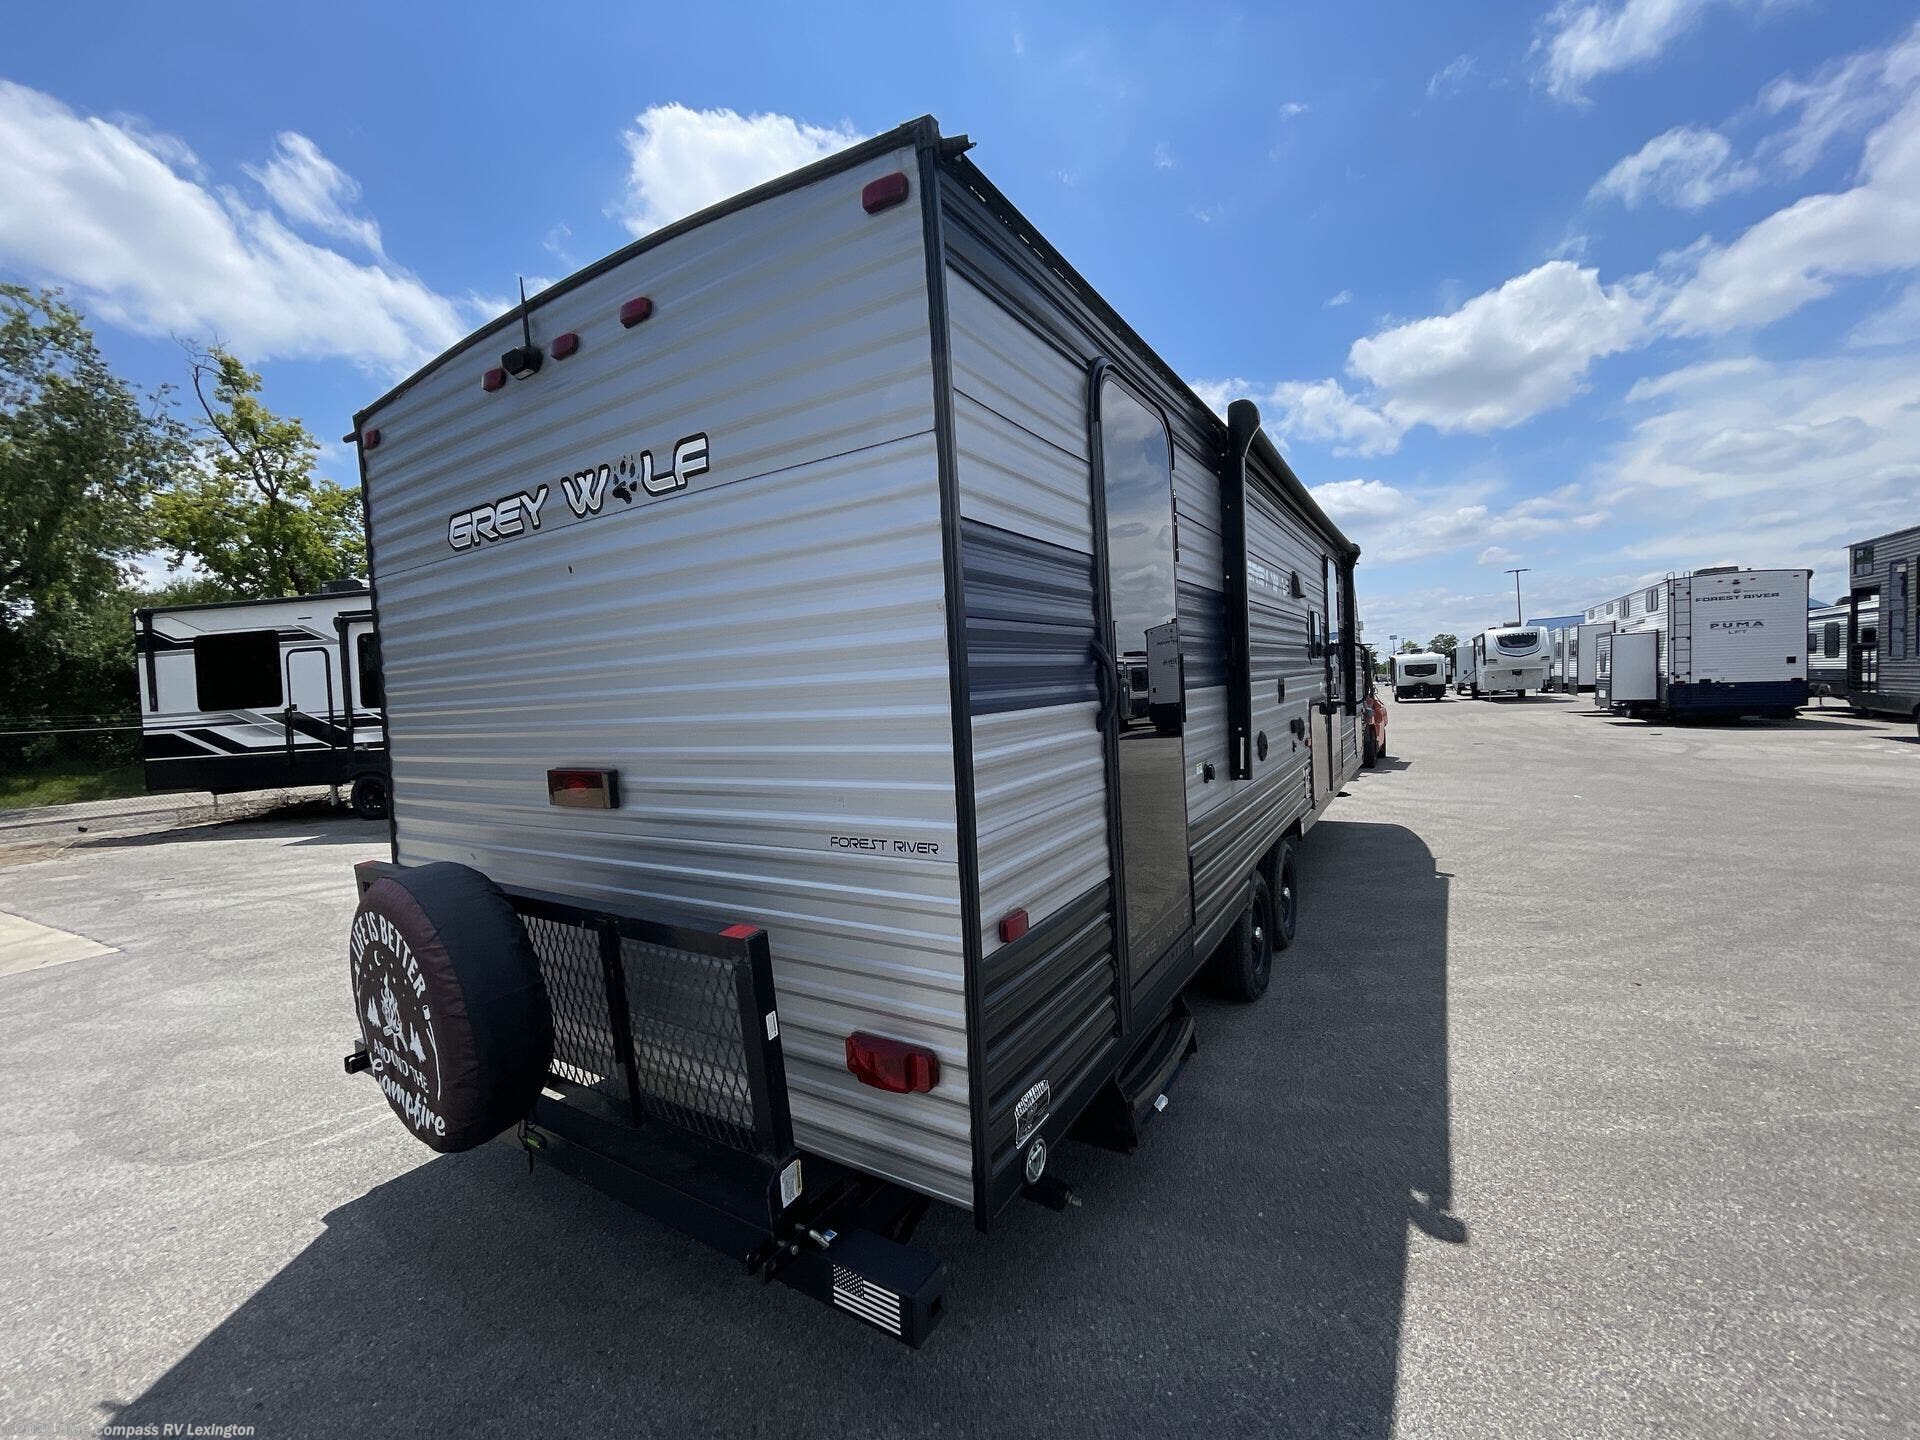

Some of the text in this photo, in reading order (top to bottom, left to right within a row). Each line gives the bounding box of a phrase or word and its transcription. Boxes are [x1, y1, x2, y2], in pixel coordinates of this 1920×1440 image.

[448, 484, 549, 551] GREY
[1743, 592, 1780, 600] RIVER
[1710, 621, 1764, 629] PUMA
[830, 836, 939, 855] FOREST RIVER
[351, 911, 426, 999] LIFE IS BETTER
[373, 1038, 430, 1094] AROUND THE
